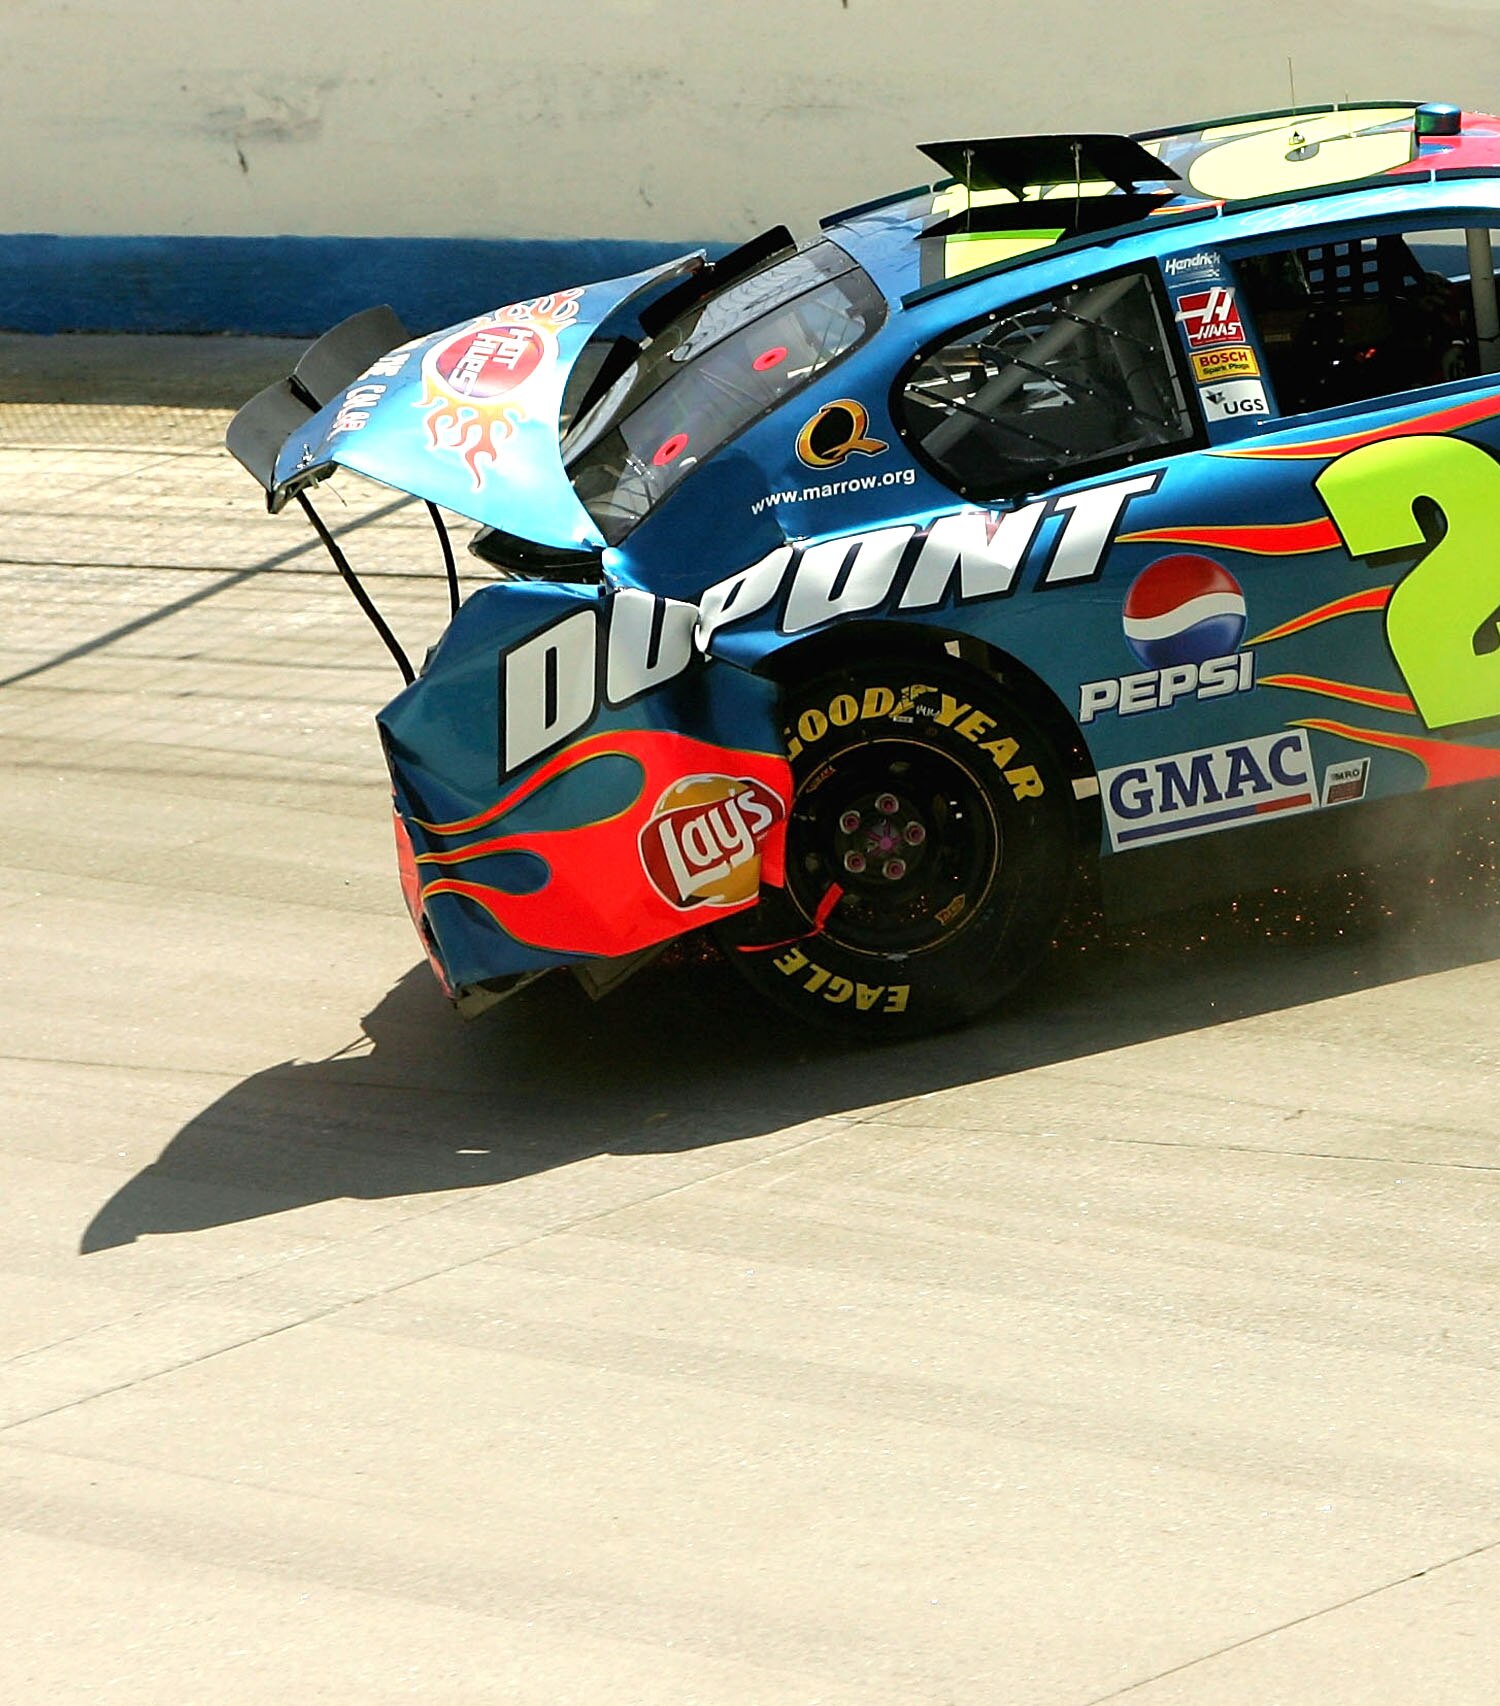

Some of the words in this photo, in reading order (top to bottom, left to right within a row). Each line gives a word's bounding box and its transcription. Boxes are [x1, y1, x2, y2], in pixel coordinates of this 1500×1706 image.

[1165, 252, 1221, 276] Hendrick
[495, 328, 535, 370] HOT
[1197, 321, 1243, 340] HAAS
[1199, 351, 1248, 367] BOSCH
[1223, 398, 1265, 415] UGS
[750, 468, 917, 516] www.marrow.org
[503, 472, 1159, 775] DUPONT
[1078, 650, 1256, 723] PEPSI
[1108, 735, 1308, 821] GMAC
[659, 787, 774, 902] Lay's
[772, 947, 911, 1013] EAGLE
